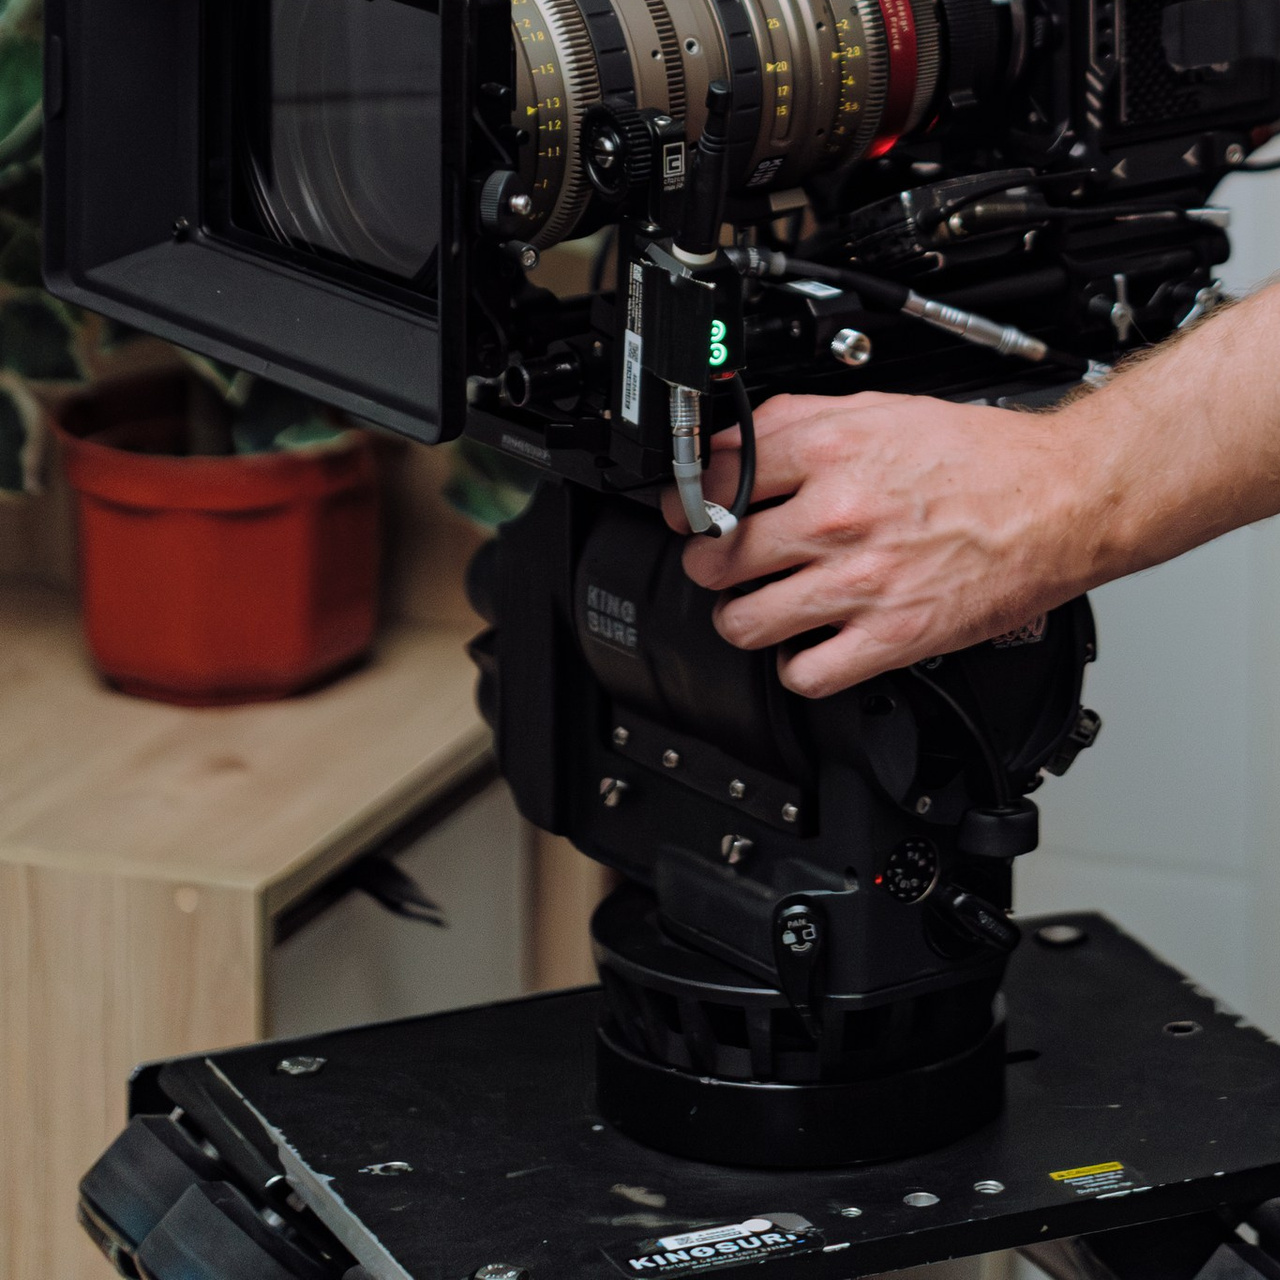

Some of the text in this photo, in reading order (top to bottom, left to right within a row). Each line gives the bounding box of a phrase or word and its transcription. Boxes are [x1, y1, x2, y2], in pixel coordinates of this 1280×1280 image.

[767, 18, 780, 29] 25
[889, 16, 901, 50] France
[776, 61, 788, 72] 20
[777, 86, 789, 97] 17
[776, 105, 788, 116] 15
